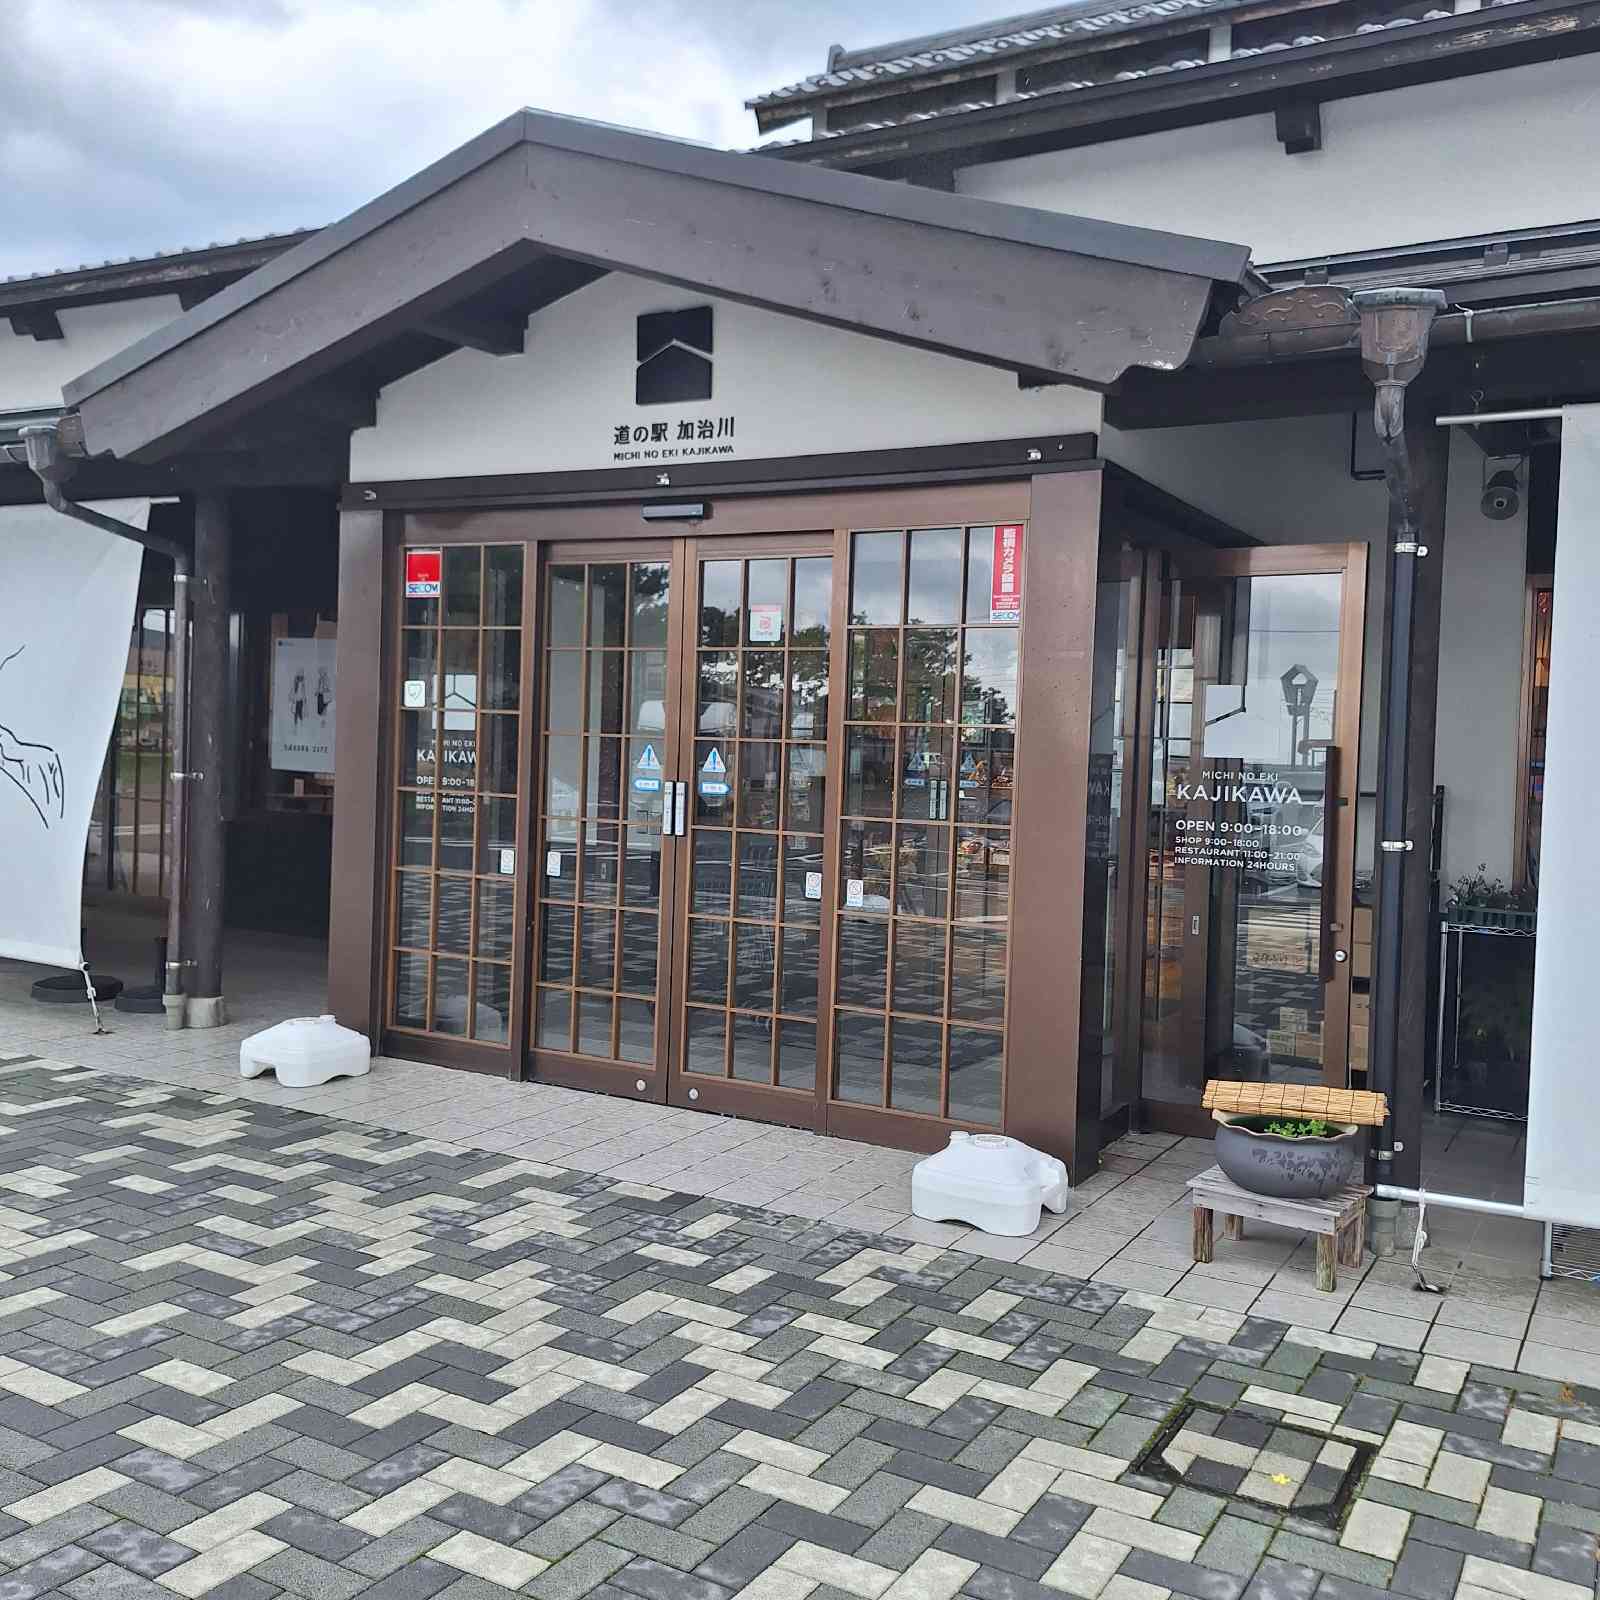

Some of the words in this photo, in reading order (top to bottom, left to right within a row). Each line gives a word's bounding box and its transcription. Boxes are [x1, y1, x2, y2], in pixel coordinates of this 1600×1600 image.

[614, 423, 668, 445] 道の駅
[677, 416, 735, 441] 加治川
[614, 451, 640, 461] MICHI
[644, 450, 659, 459] NO
[662, 449, 678, 458] EKI
[682, 445, 735, 456] KAJIKAWA
[408, 583, 439, 593] SECOM
[1202, 771, 1234, 780] MICHI
[1238, 772, 1255, 781] NO
[1259, 772, 1278, 781] EKI
[1176, 784, 1302, 804] KAJIKAWA
[1175, 819, 1216, 832] OPEN
[1220, 822, 1303, 837] 9:00-18:00
[1175, 836, 1202, 845] SHOP
[1175, 846, 1240, 858] RESTAURANT
[1174, 857, 1244, 868] INFORMATION
[1247, 861, 1295, 871] 24HOURS
